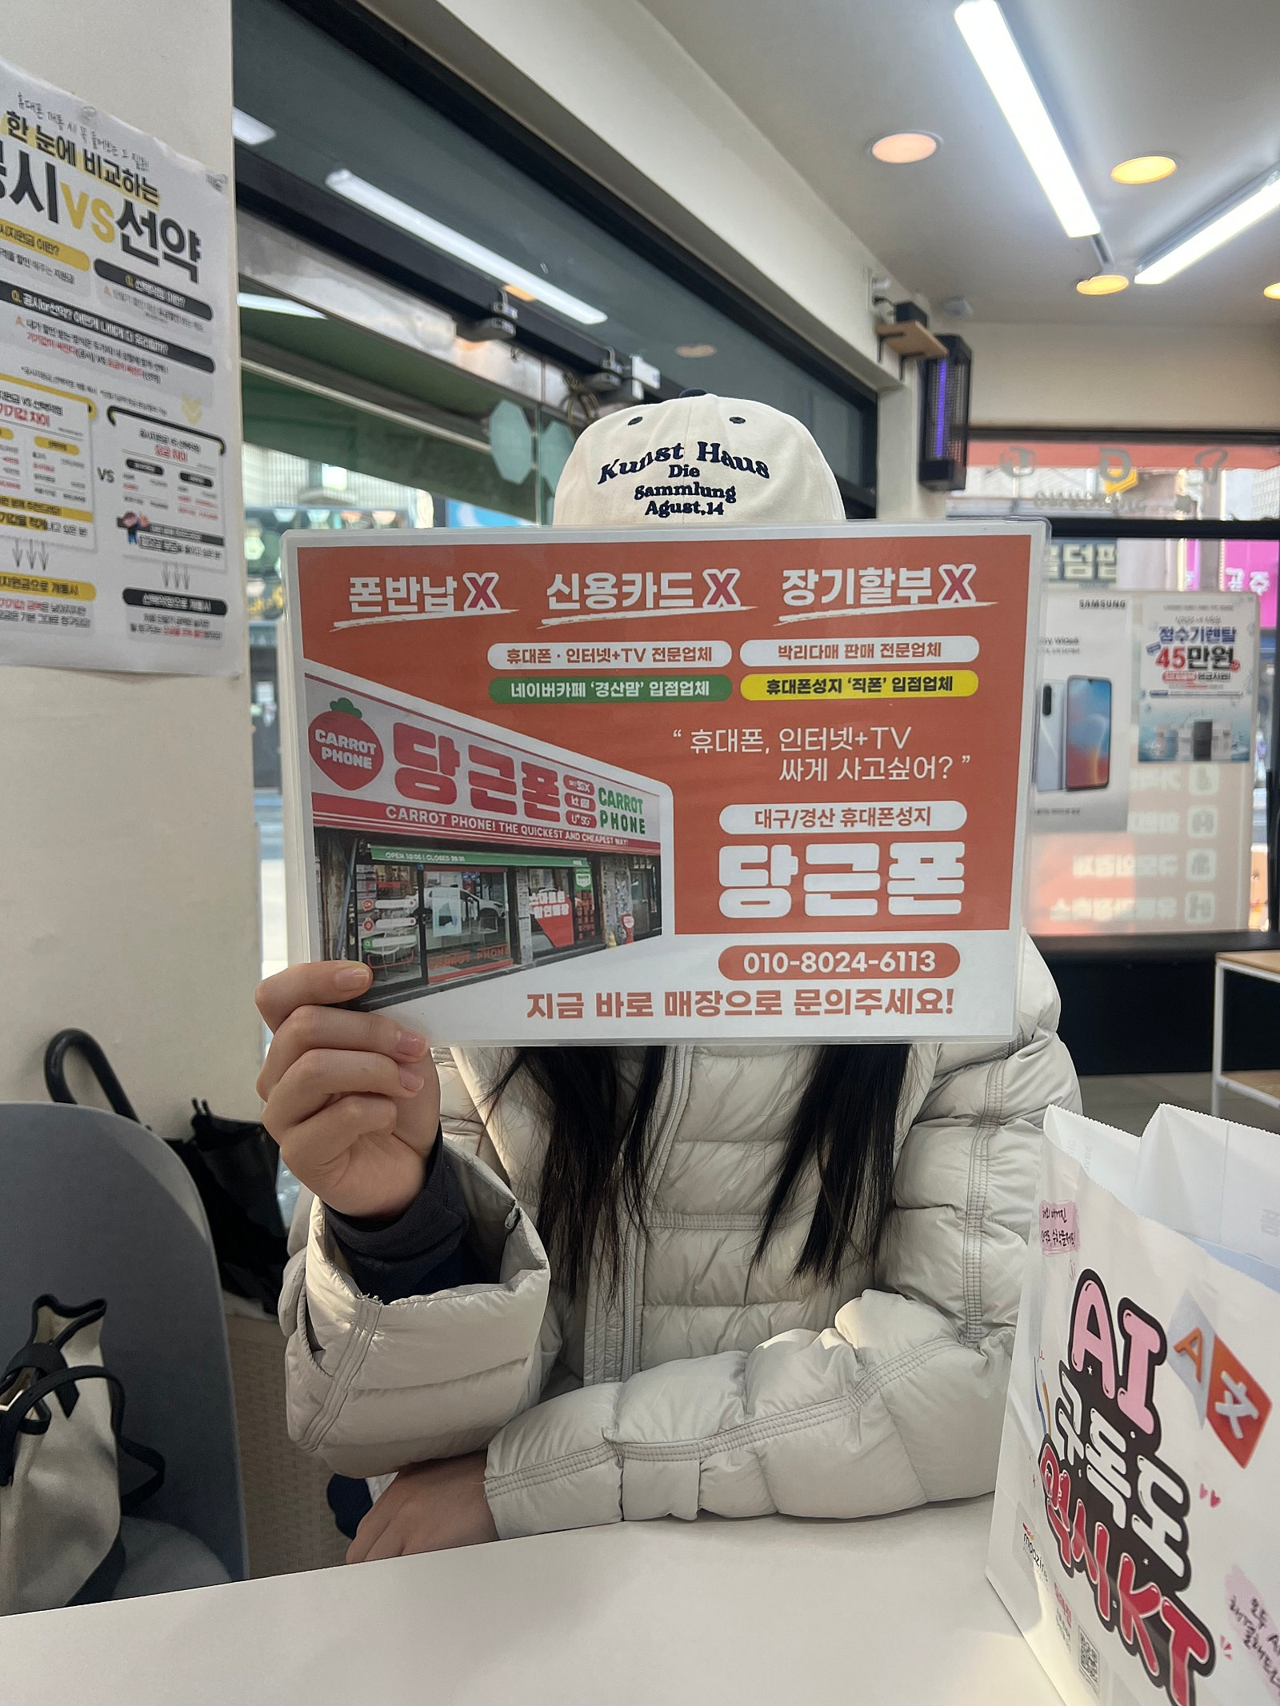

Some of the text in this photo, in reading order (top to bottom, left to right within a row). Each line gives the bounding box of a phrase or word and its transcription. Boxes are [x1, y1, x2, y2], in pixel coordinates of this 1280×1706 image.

[7, 110, 29, 143] 한
[36, 124, 77, 167] 눈에
[82, 148, 159, 206] 비교하는
[97, 466, 115, 483] VS
[597, 441, 770, 485] Kunst Haus
[668, 464, 701, 479] Die
[1079, 600, 1126, 609] SAMSUNG
[1159, 626, 1237, 645] 정수기렌탈
[507, 646, 712, 665] 휴대폰 인터넷+TV 전문업체
[778, 641, 942, 660] 박리다매 판매 전문업체
[1155, 646, 1234, 670] 45만원
[510, 682, 586, 699] 네이버카페
[649, 680, 710, 698] 입점업체
[766, 677, 843, 696] 휴대폰성지
[892, 675, 954, 693] 입점업체
[314, 729, 377, 756] CARROT
[690, 726, 912, 754] 휴대폰, 인터넷+TV
[321, 747, 372, 771] PHONE
[779, 756, 953, 782] 싸게 사고싶어?
[393, 722, 561, 822] 당근폰
[598, 787, 644, 815] CARROT
[386, 805, 449, 826] CARROT
[451, 815, 496, 832] PHONE!
[499, 821, 519, 835] THE
[521, 825, 564, 840] QUICKEST
[565, 831, 581, 841] AND
[600, 810, 646, 834] PHONE
[754, 806, 932, 829] 대구/경산 휴대폰성지
[719, 841, 965, 918] 당근폰
[743, 950, 937, 974] 010-8024-6113
[527, 987, 955, 1020] 지금 바로 매장으로 문의주세요!
[1069, 1279, 1161, 1435] AI
[1119, 1552, 1208, 1706] KT
